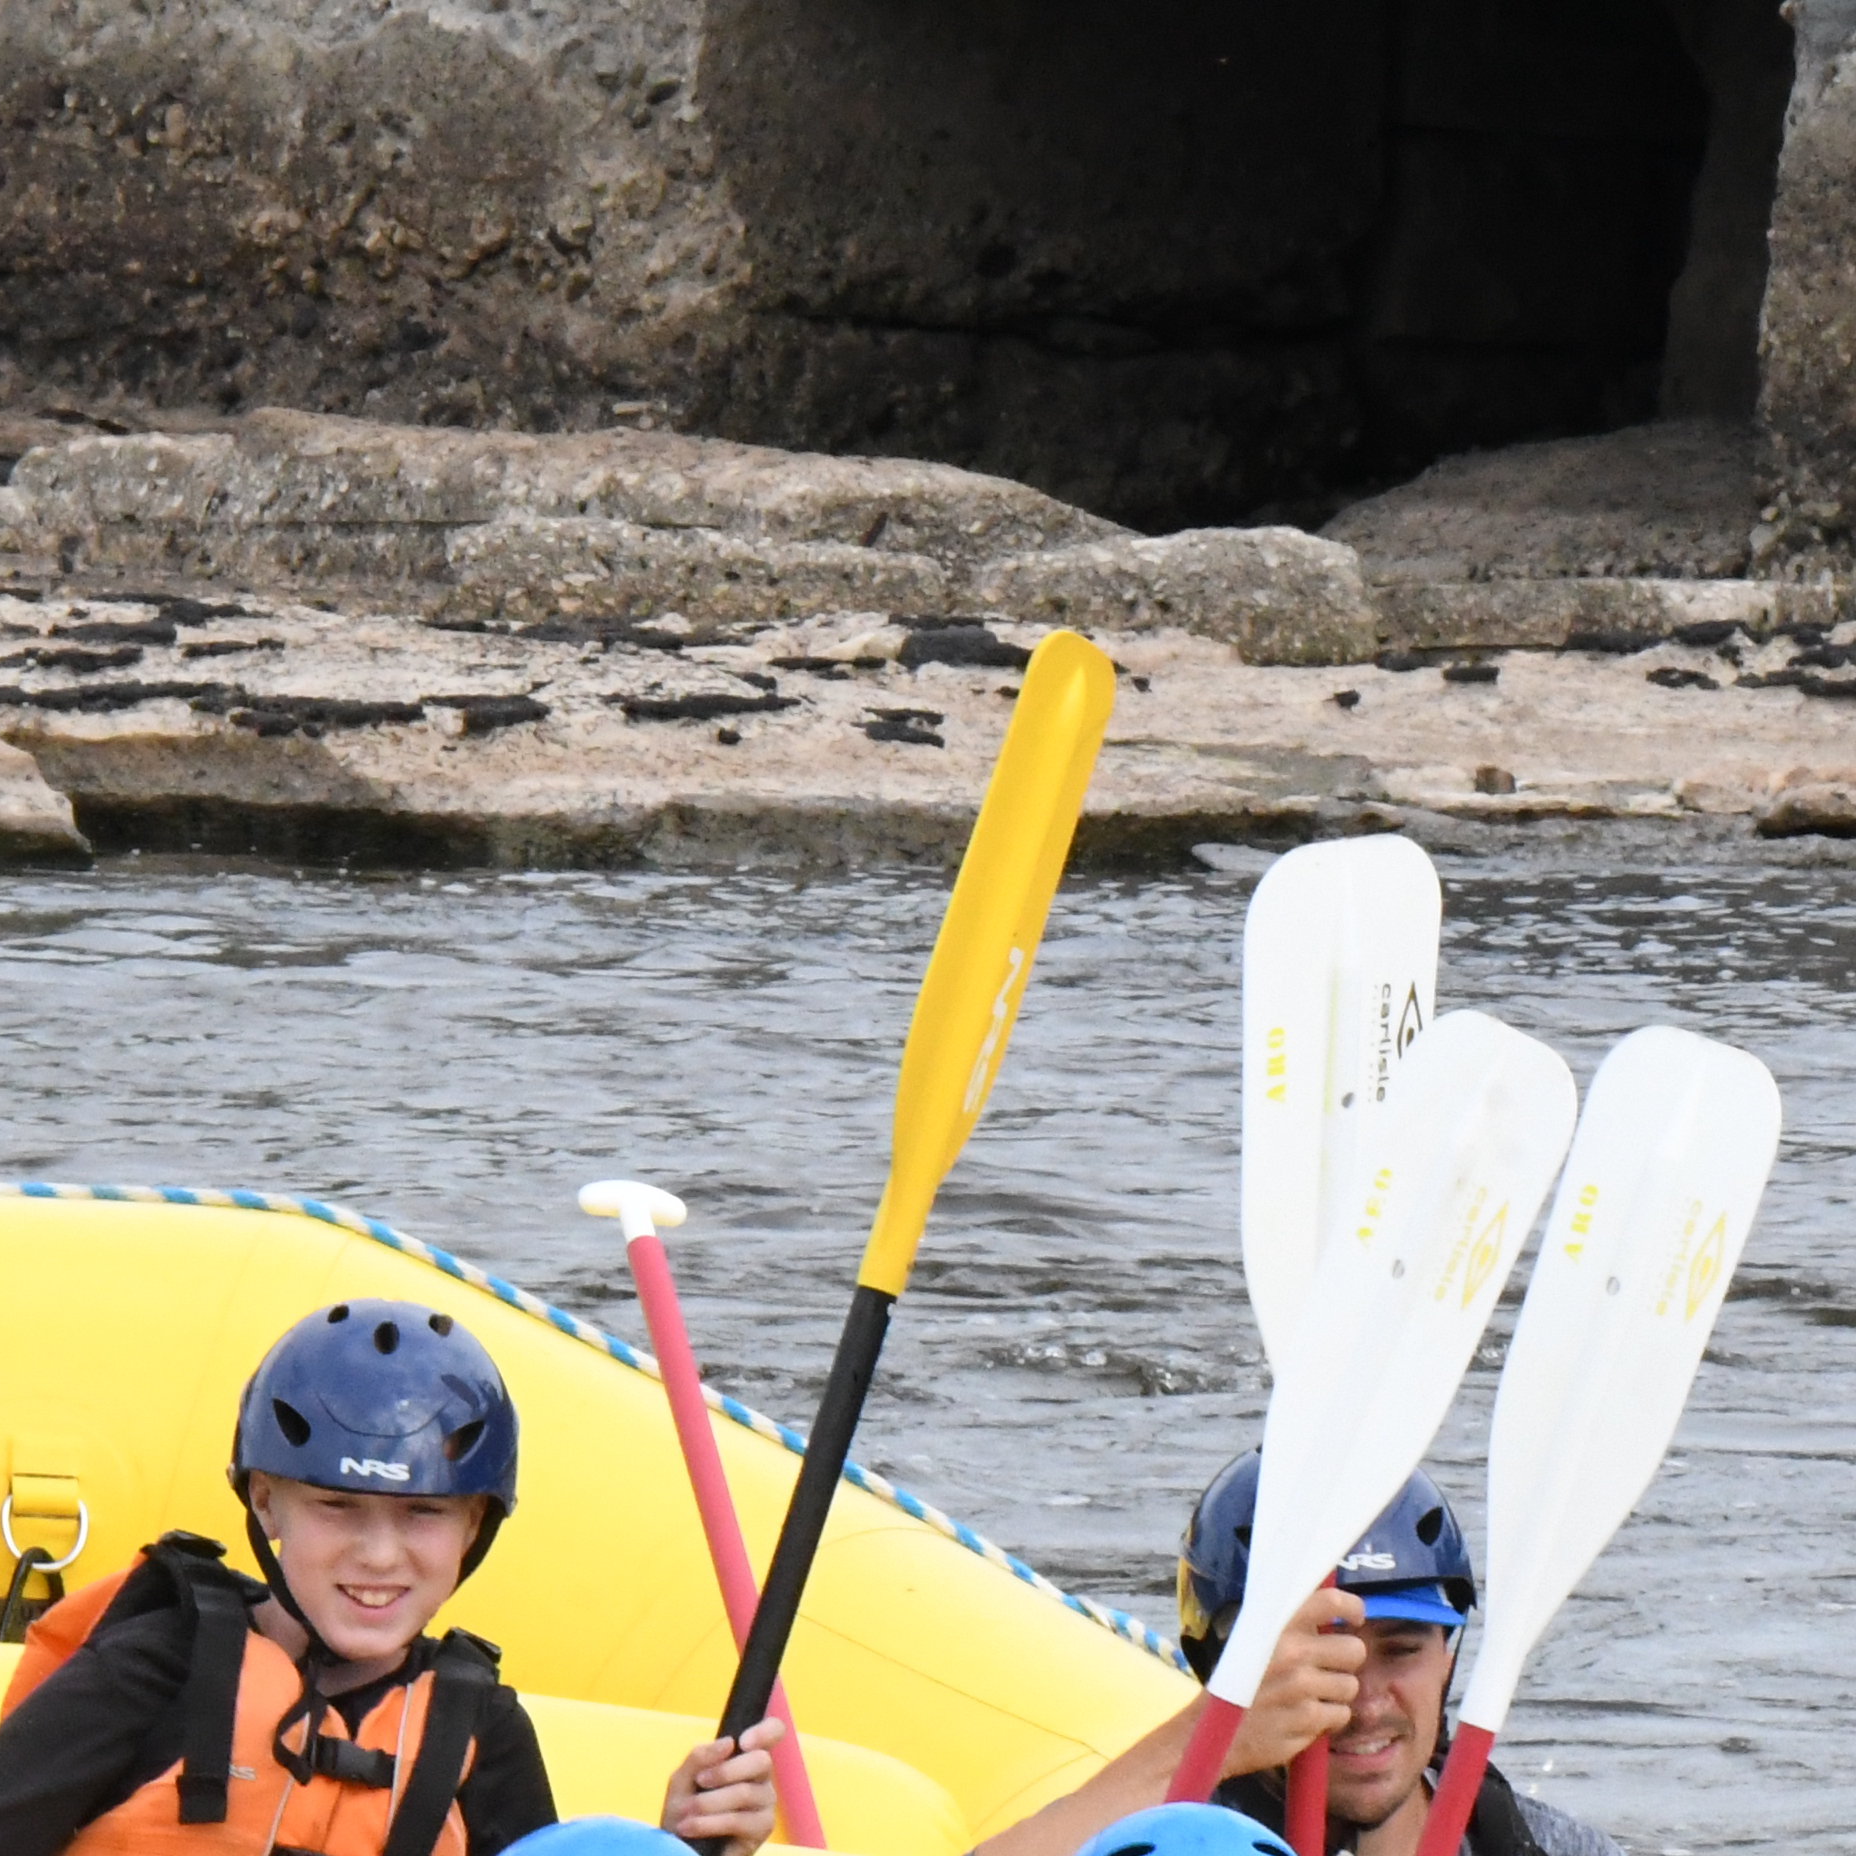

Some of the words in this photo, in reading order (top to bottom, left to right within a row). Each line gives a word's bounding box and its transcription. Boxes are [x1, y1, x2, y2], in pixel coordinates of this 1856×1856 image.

[1264, 1026, 1287, 1104] ARO
[1376, 982, 1393, 1104] carlisle
[1563, 1184, 1600, 1264] ARO
[339, 1456, 411, 1481] NRS
